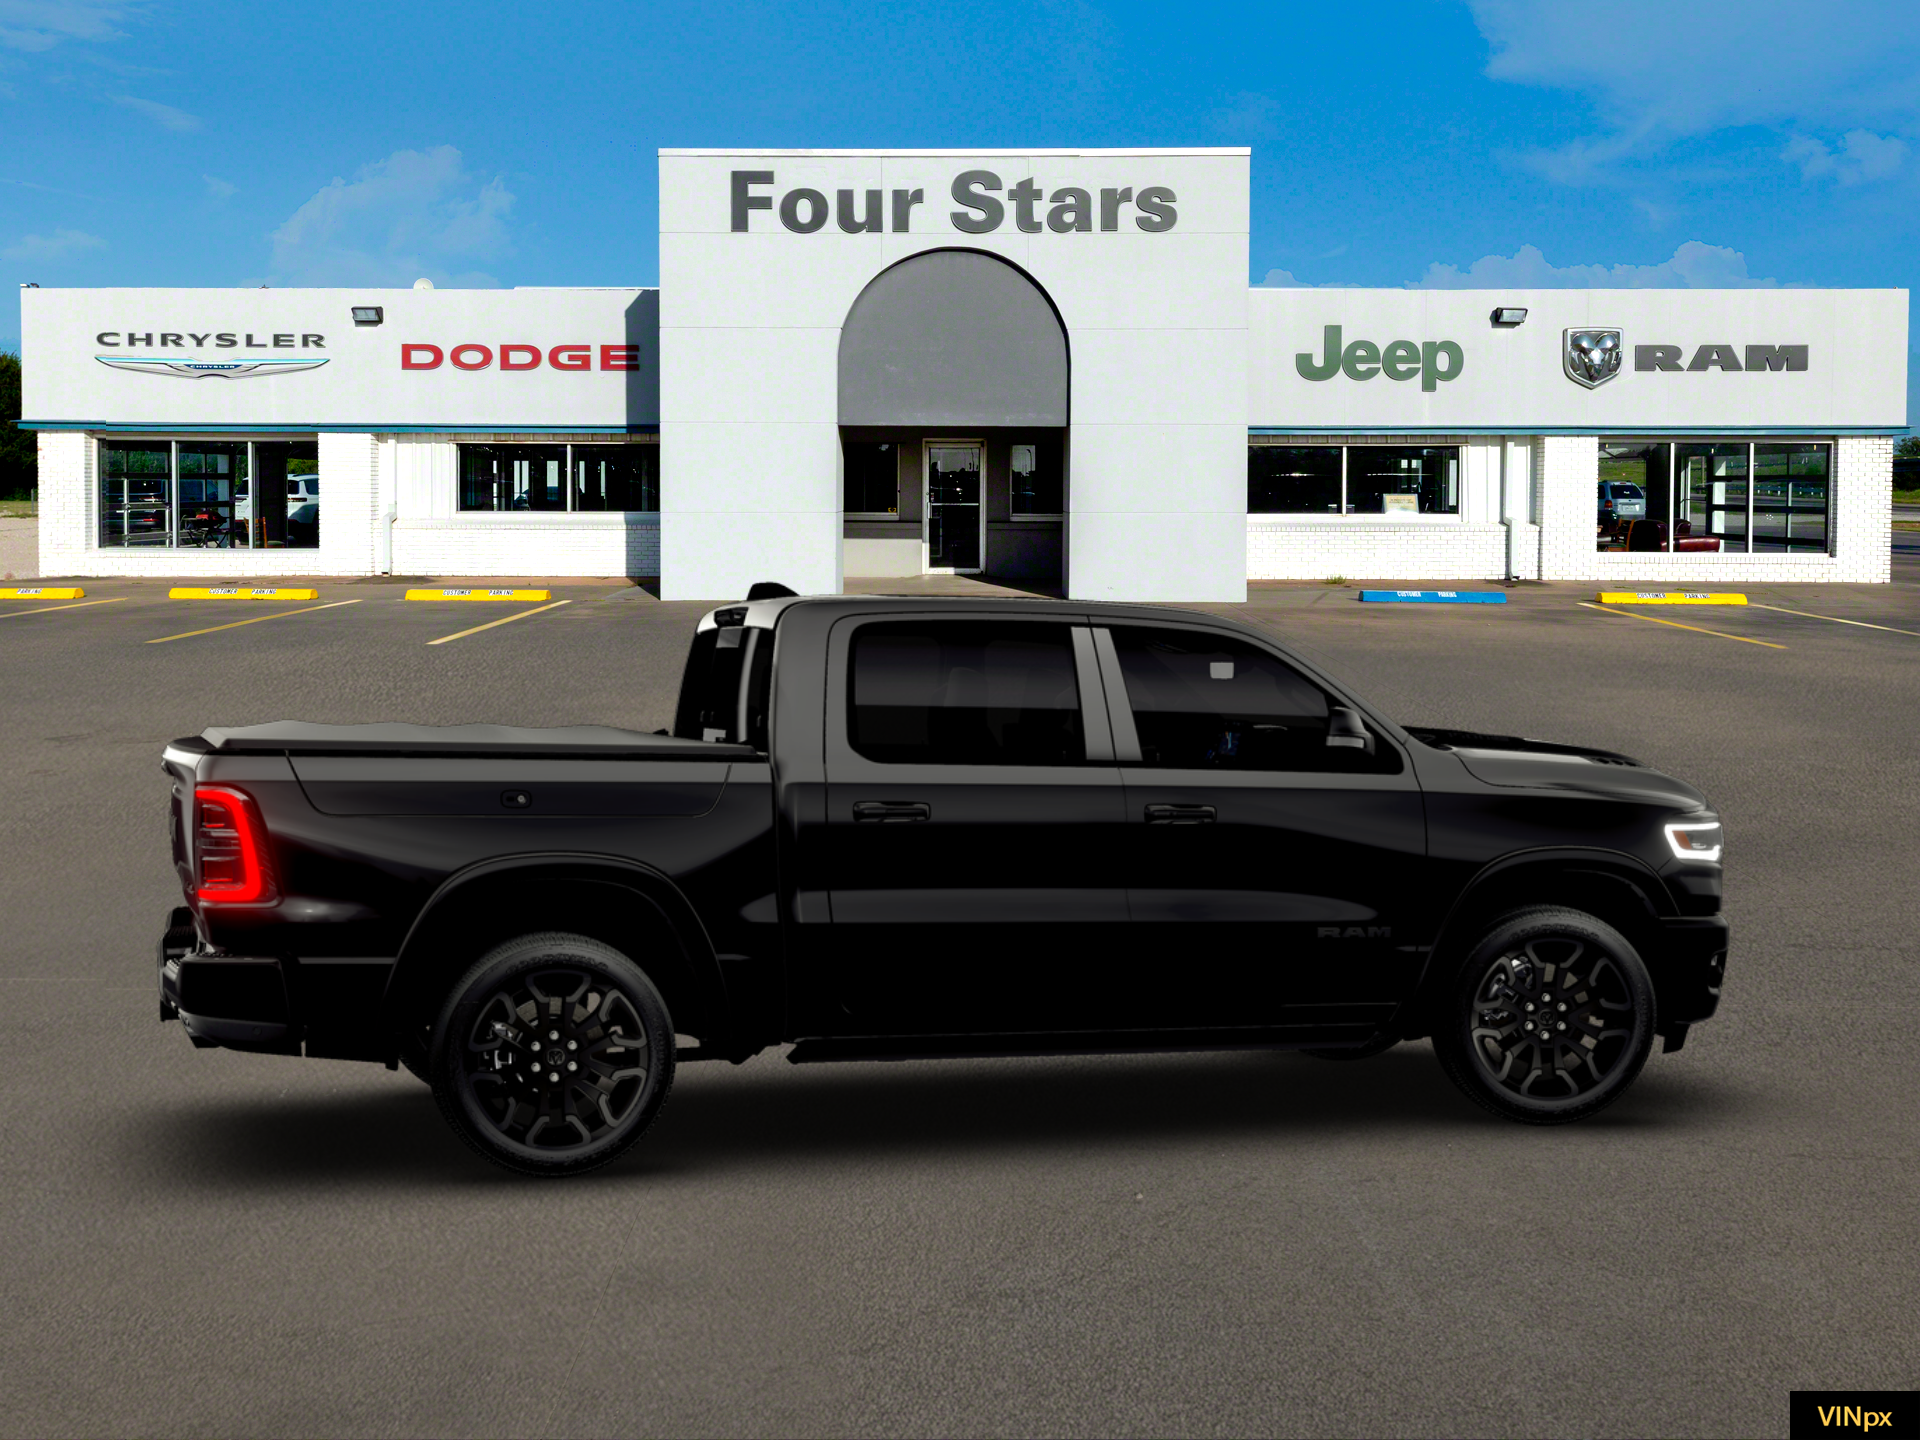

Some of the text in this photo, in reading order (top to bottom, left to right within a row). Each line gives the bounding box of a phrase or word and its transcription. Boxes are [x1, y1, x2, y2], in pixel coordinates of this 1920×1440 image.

[731, 169, 1178, 233] Four Stars
[96, 332, 326, 348] CHRYSLER
[401, 343, 640, 371] DODGE
[1295, 325, 1464, 392] Jeep
[1634, 344, 1809, 371] RAM
[1317, 926, 1392, 938] RAM
